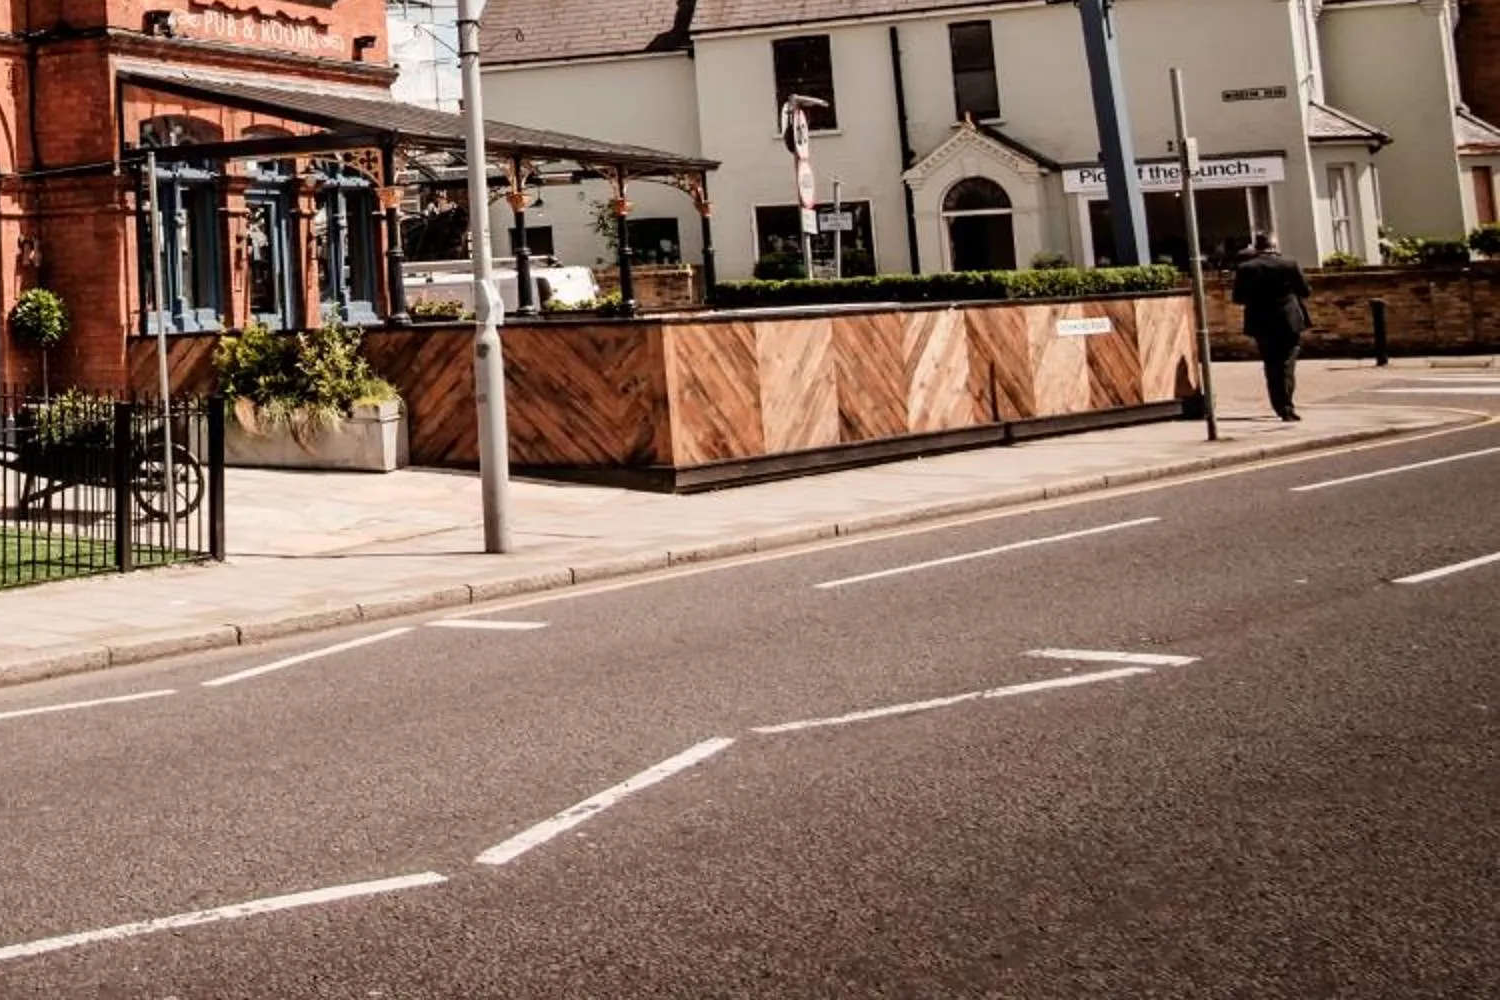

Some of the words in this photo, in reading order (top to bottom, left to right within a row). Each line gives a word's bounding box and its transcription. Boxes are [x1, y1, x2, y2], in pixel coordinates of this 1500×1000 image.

[203, 10, 238, 37] PUB
[243, 16, 257, 40] &
[261, 18, 318, 50] ROOMS
[1148, 164, 1181, 179] the
